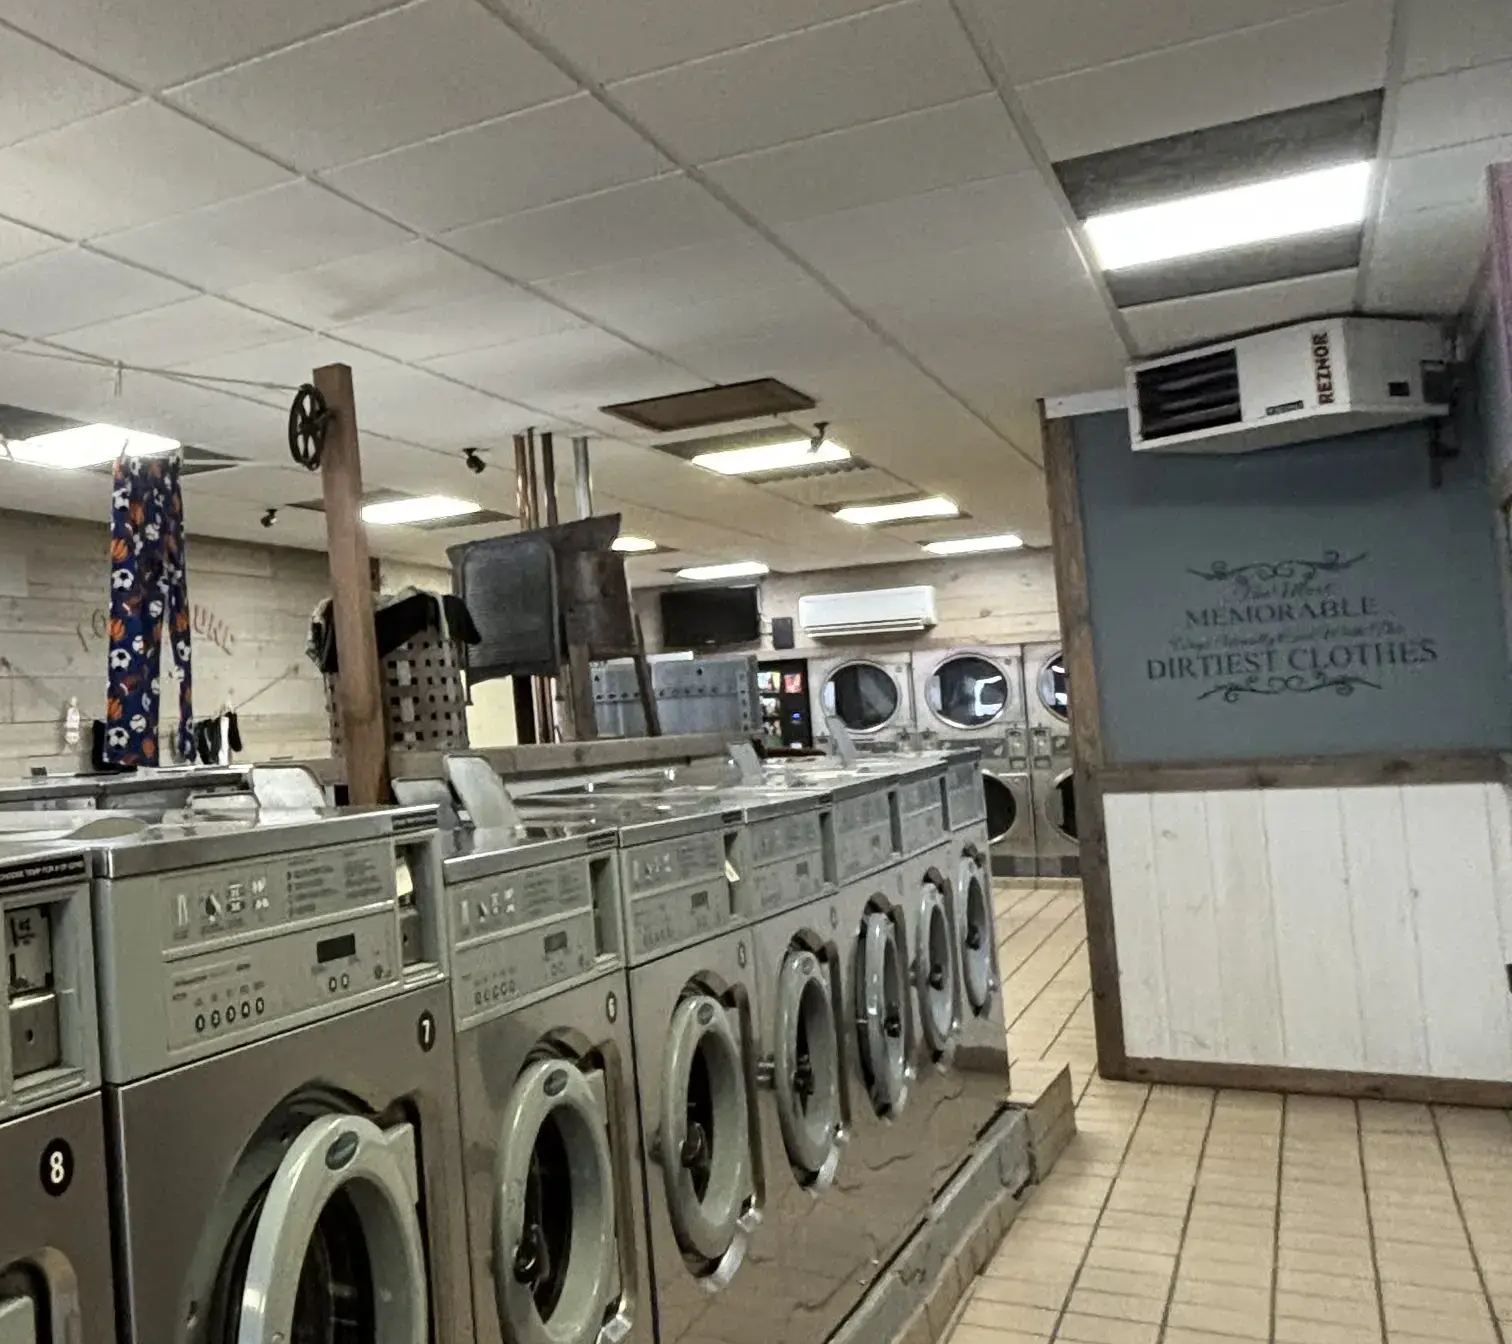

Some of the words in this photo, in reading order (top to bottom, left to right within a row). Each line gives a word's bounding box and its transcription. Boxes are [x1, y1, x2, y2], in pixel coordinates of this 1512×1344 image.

[1312, 331, 1335, 405] REZNOR
[1185, 596, 1380, 628] MEMORABLE
[1146, 649, 1276, 680] DIRTIEST
[1288, 637, 1439, 673] CLOTHES
[50, 1150, 65, 1184] 8
